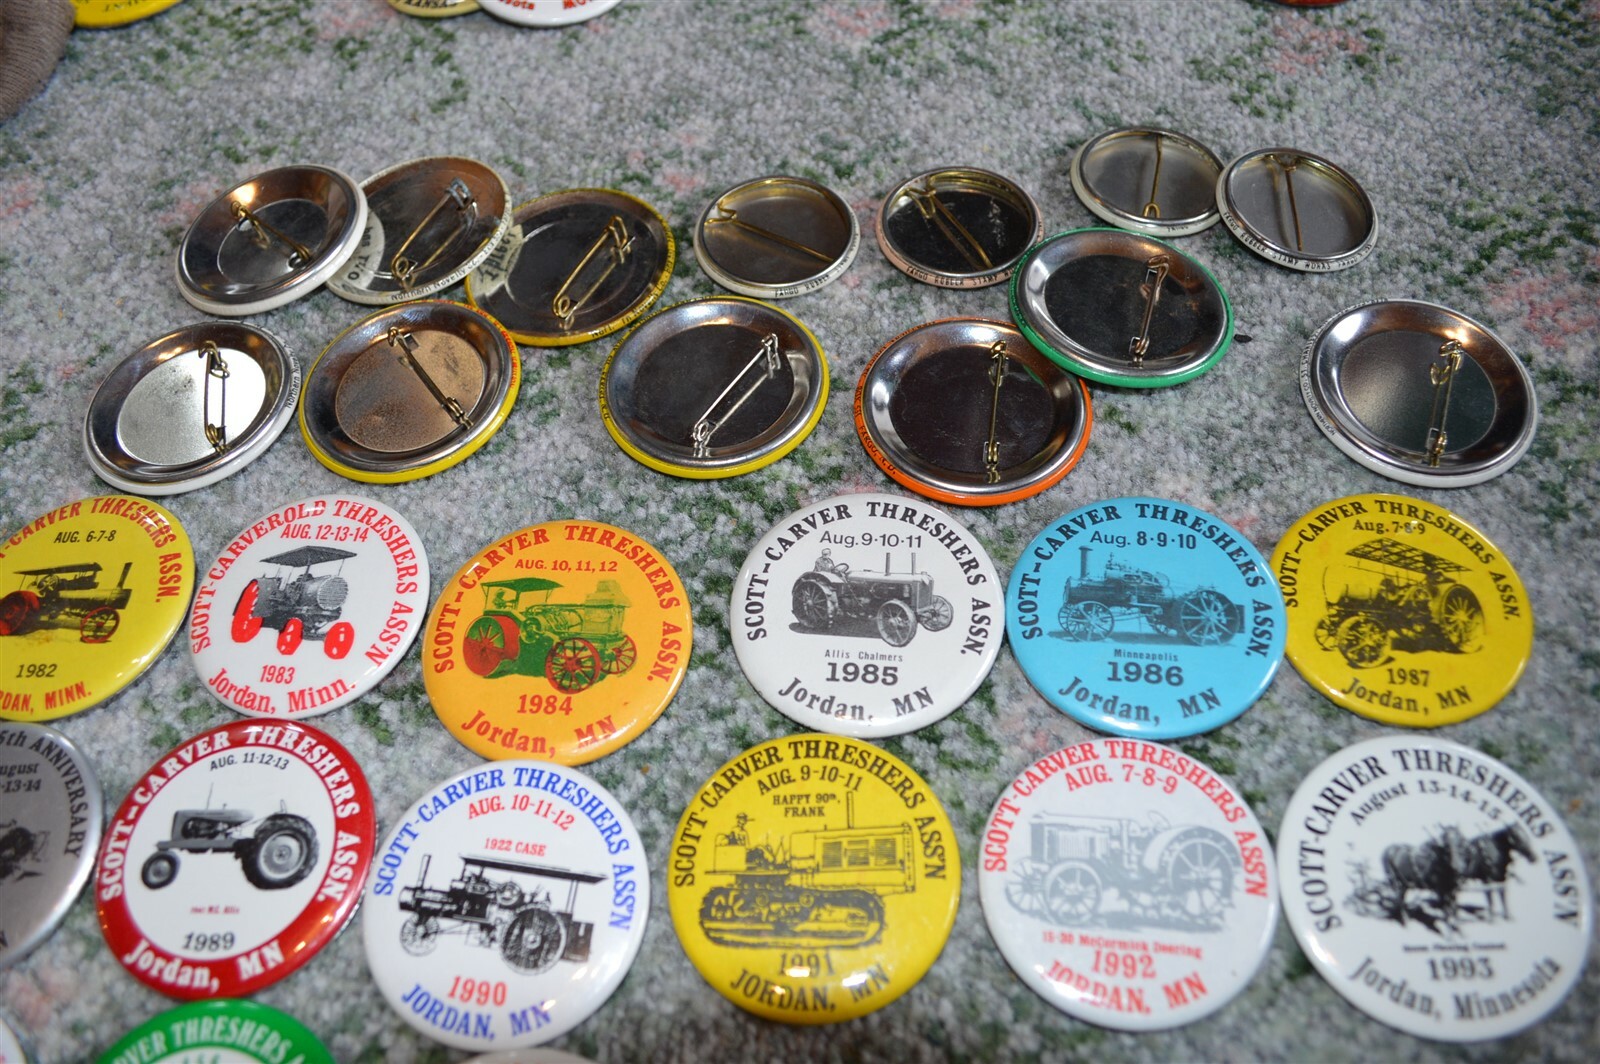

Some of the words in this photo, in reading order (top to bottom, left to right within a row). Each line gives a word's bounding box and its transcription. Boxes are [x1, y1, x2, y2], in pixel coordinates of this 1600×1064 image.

[54, 530, 80, 544] AUG.
[86, 530, 117, 543] 6-7-8
[280, 524, 311, 540] AUG.
[315, 525, 370, 543] 12-13-14
[819, 530, 858, 549] Aug.
[1090, 531, 1131, 548] Aug.
[1353, 519, 1390, 535] Aug.
[0, 501, 82, 558] -CARVER
[156, 552, 182, 603] ASSN.
[333, 499, 418, 595] THRESHERS
[1374, 499, 1495, 565] THRESHERS
[1489, 570, 1521, 621] ASSN.
[514, 559, 547, 570] AUG.
[599, 560, 618, 572] 12
[866, 501, 987, 586] THRESHERS
[960, 597, 991, 656] ASSN.
[1135, 503, 1267, 588] THRESHERS
[1245, 599, 1275, 658] ASSN.
[564, 525, 682, 610] THRESHERS
[646, 621, 683, 683] ASSN.
[16, 663, 58, 678] 1982
[824, 649, 850, 660] Allis
[858, 651, 903, 663] Chalmers
[1113, 649, 1179, 664] Minneapolis
[260, 665, 296, 685] 1983
[825, 662, 899, 686] 1985
[1107, 661, 1184, 687] 1986
[1387, 668, 1430, 687] 1987
[45, 681, 92, 710] MINN.
[209, 668, 276, 715] Jordan,
[287, 678, 356, 713] Minn.
[517, 694, 573, 716] 1984
[891, 686, 935, 718] MN
[1058, 676, 1160, 726] Jordan,
[1177, 687, 1222, 719] MN
[1342, 677, 1430, 715] Jordan,
[1436, 685, 1473, 710] MN
[461, 710, 556, 758] Jordan,
[574, 715, 619, 749] MN
[209, 754, 237, 771] AUG.
[788, 740, 926, 810] THRESHERS
[800, 765, 863, 792] 9-10-11
[1064, 764, 1113, 791] AUG.
[1122, 764, 1178, 794] 7-8-9
[1104, 740, 1247, 823] THRESHERS
[1392, 748, 1555, 839] THRESHERS
[28, 736, 88, 859] ANNIVERSARY
[468, 795, 505, 820] AUG.
[510, 794, 577, 831] 10-11-12
[513, 767, 630, 855] THRESHERS
[772, 794, 813, 806] HAPPY
[784, 806, 826, 818] FRANK
[1349, 782, 1409, 826] August
[1417, 779, 1504, 820] 13-14-15
[246, 726, 360, 819] THRESHERS
[317, 831, 361, 902] ASSN.
[484, 837, 513, 851] 1922
[515, 841, 547, 856] CASE
[182, 931, 235, 952] 1989
[123, 937, 220, 991] Jordan,
[235, 939, 285, 980] MN
[779, 952, 835, 977] 1991
[1091, 950, 1157, 979] 1992
[1427, 957, 1495, 982] 1993
[448, 975, 508, 1007] 1990
[730, 968, 837, 1014] JORDAN,
[1162, 971, 1208, 1010] MN
[1349, 956, 1442, 1021] Jordan,
[1454, 955, 1563, 1020] Minnesota
[401, 983, 496, 1042] JORDAN,
[509, 1000, 553, 1038] MN
